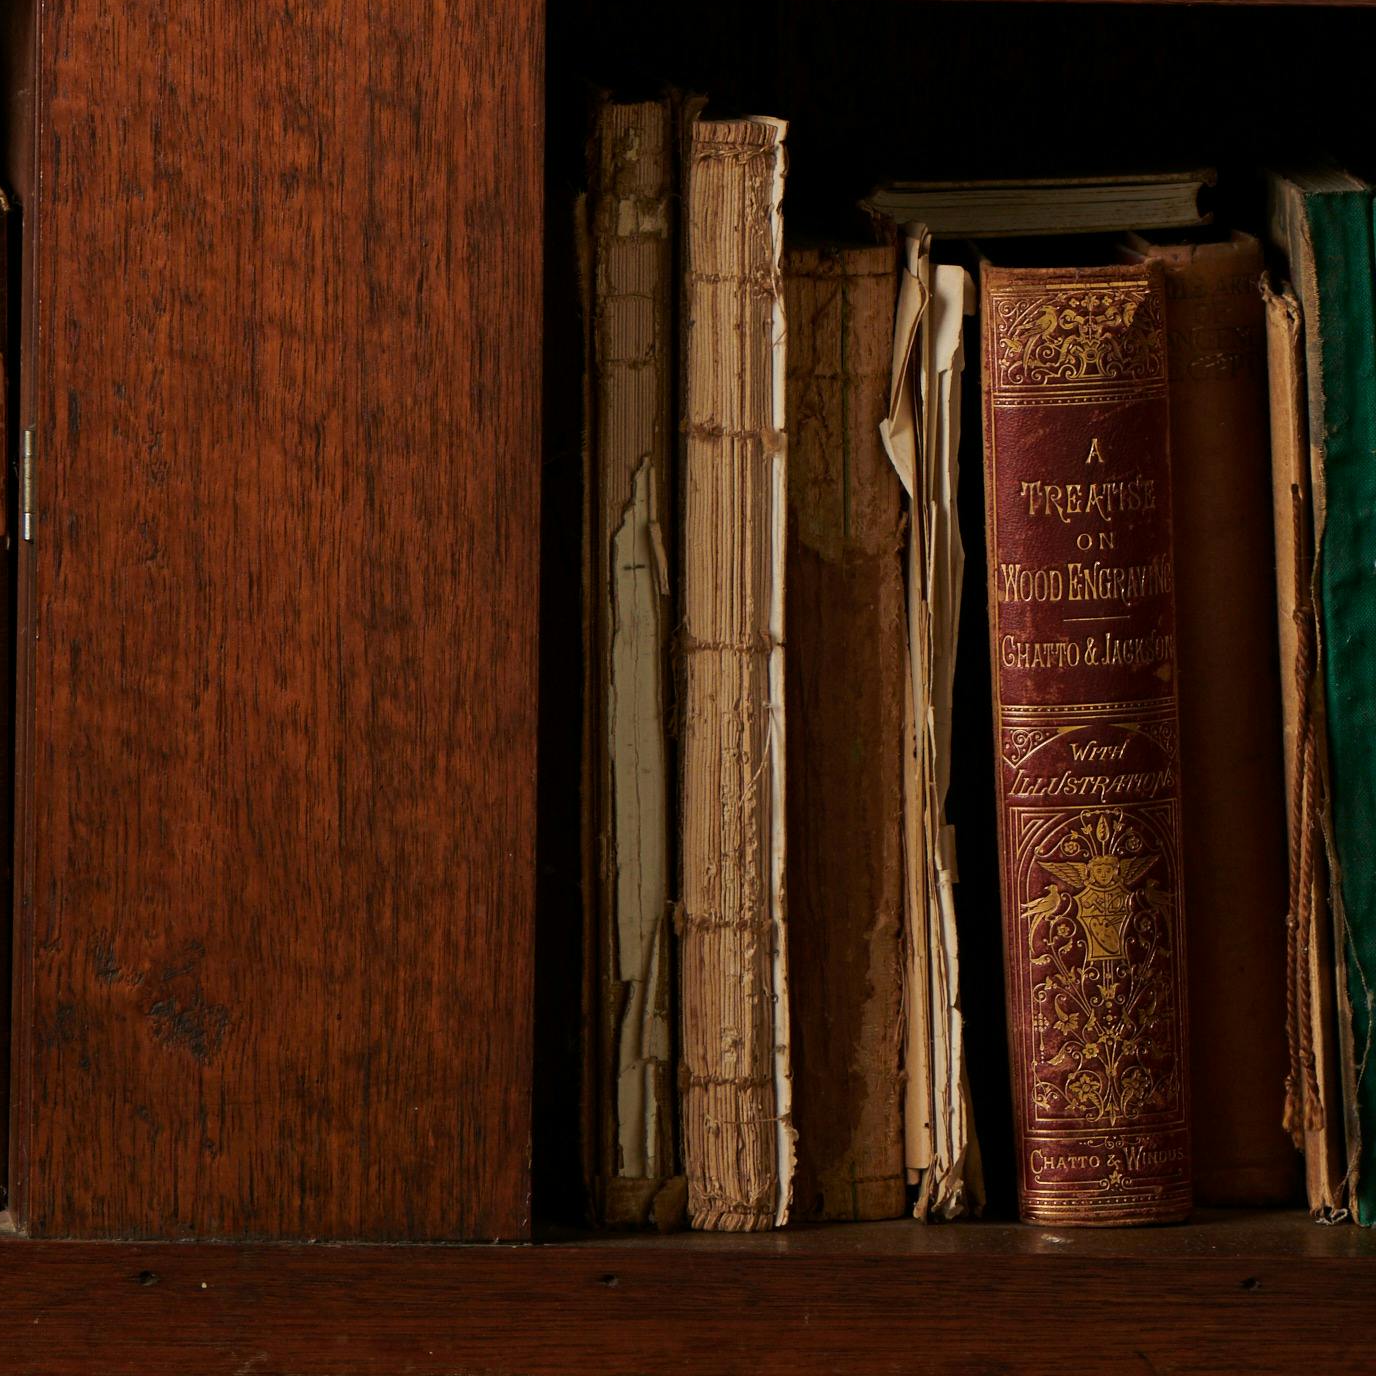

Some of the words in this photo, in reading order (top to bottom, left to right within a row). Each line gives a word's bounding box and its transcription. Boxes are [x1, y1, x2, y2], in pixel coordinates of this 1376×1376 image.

[1021, 478, 1157, 523] TREATISE
[1076, 533, 1115, 550] ON
[1001, 563, 1061, 603] WOOD
